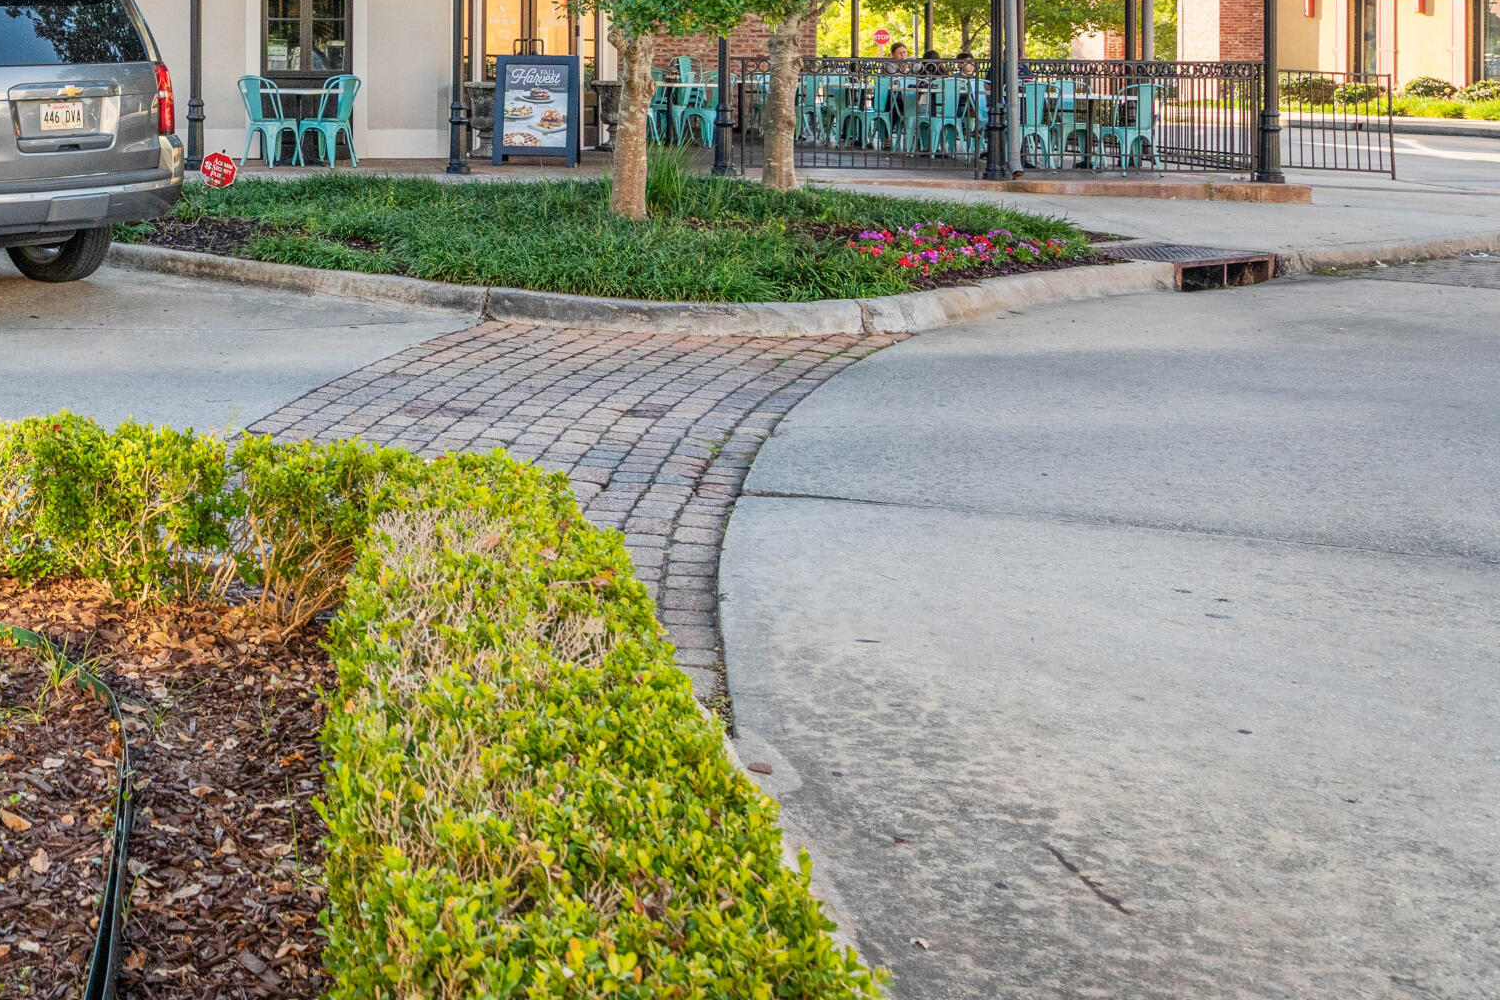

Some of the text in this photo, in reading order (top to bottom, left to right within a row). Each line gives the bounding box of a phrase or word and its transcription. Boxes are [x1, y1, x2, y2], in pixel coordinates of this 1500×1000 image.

[510, 68, 561, 86] Harvest
[44, 109, 81, 124] 446 DVA
